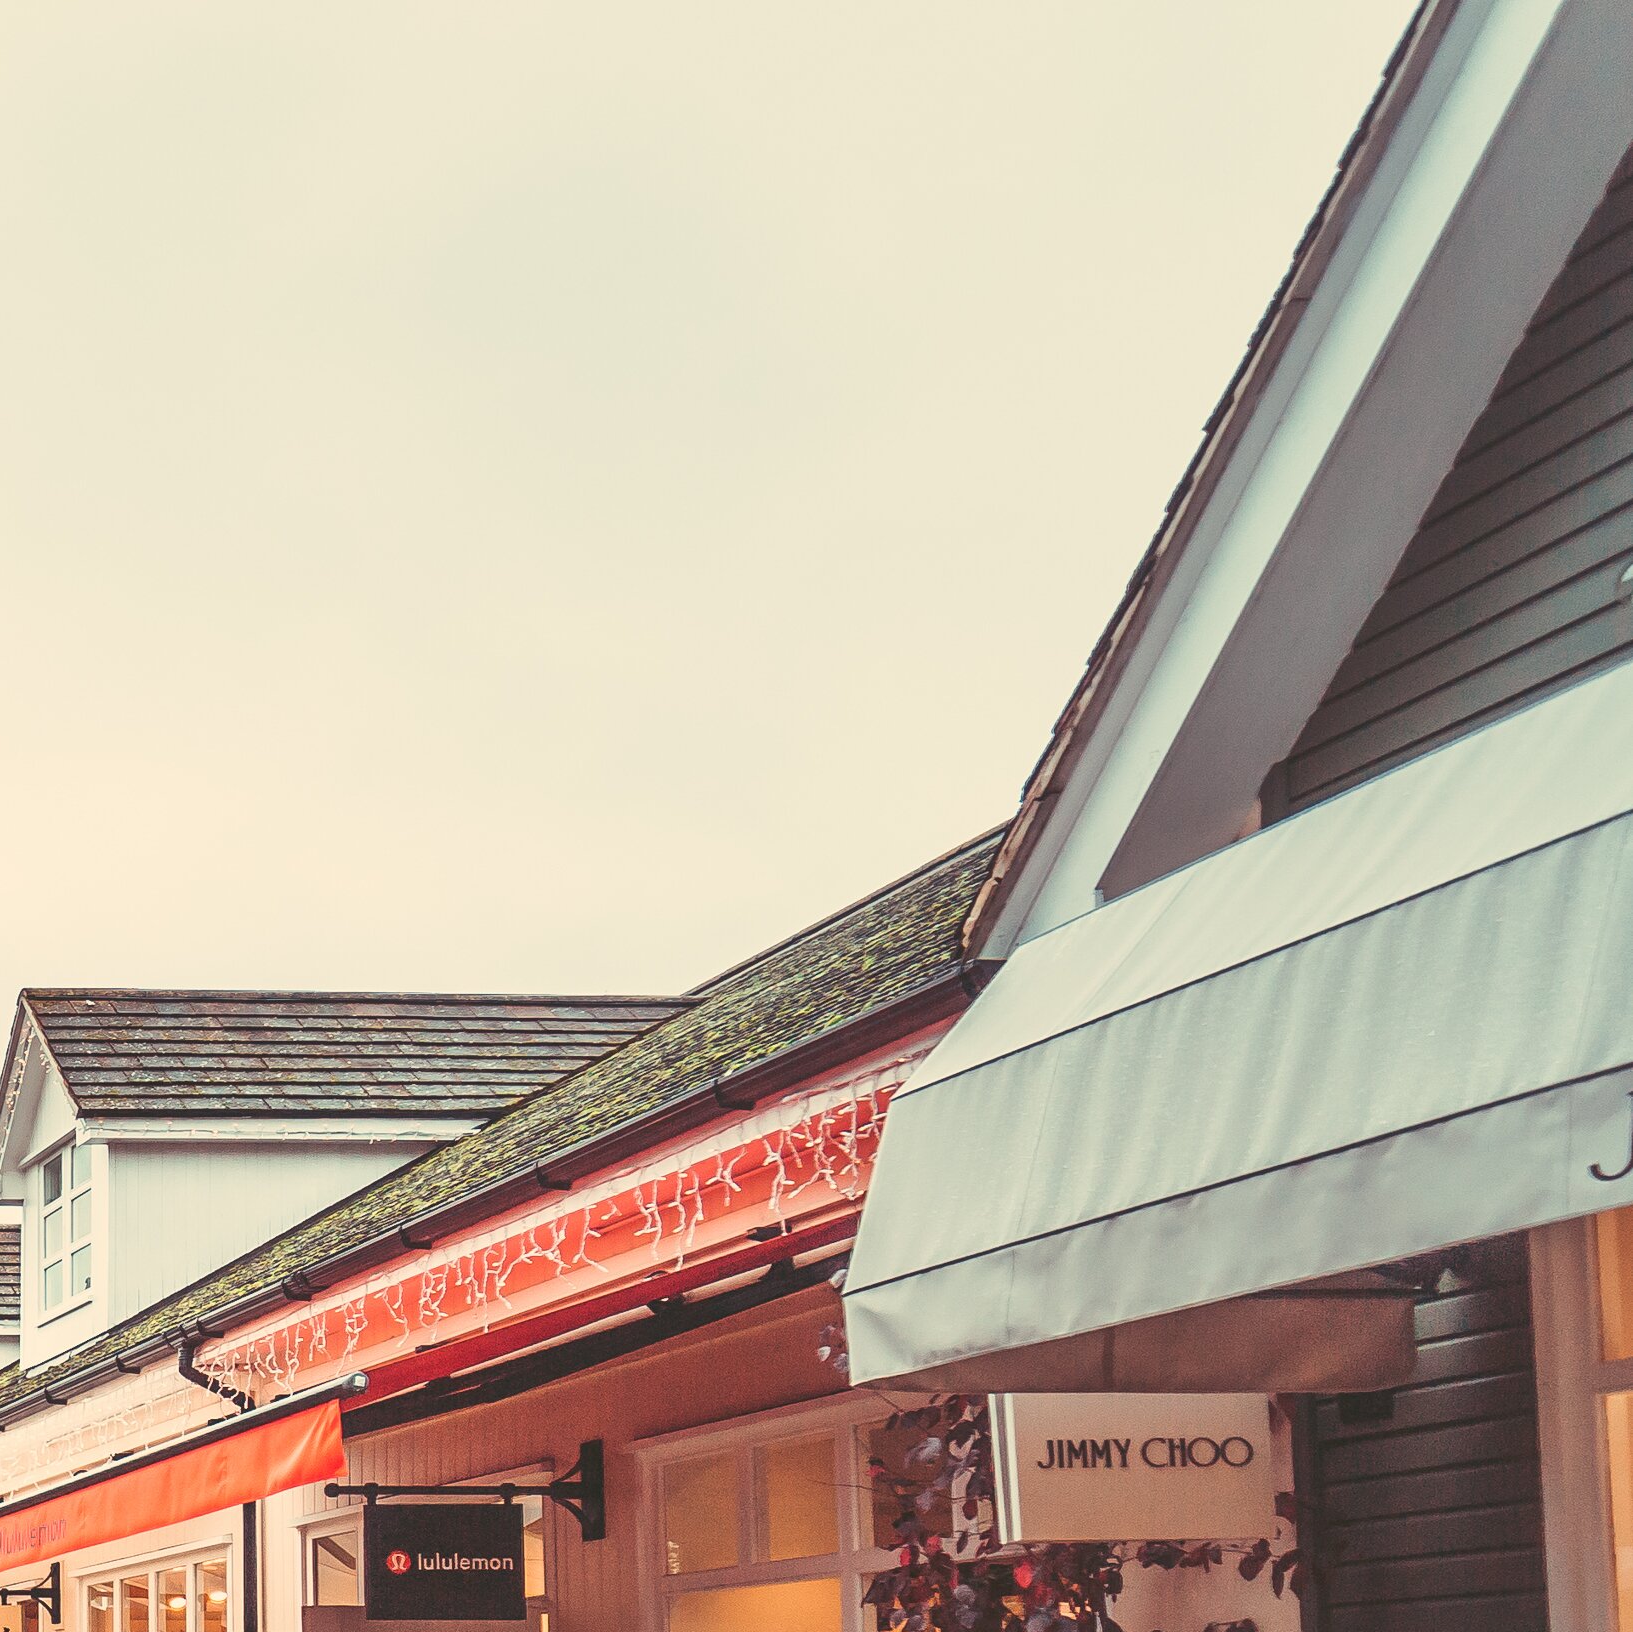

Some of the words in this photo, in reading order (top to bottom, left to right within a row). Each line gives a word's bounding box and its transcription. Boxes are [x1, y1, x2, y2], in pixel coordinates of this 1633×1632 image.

[1587, 1089, 1633, 1182] J
[1037, 1438, 1131, 1469] JIMMY
[1141, 1437, 1254, 1468] CHOO
[418, 1553, 513, 1570] lululemon
